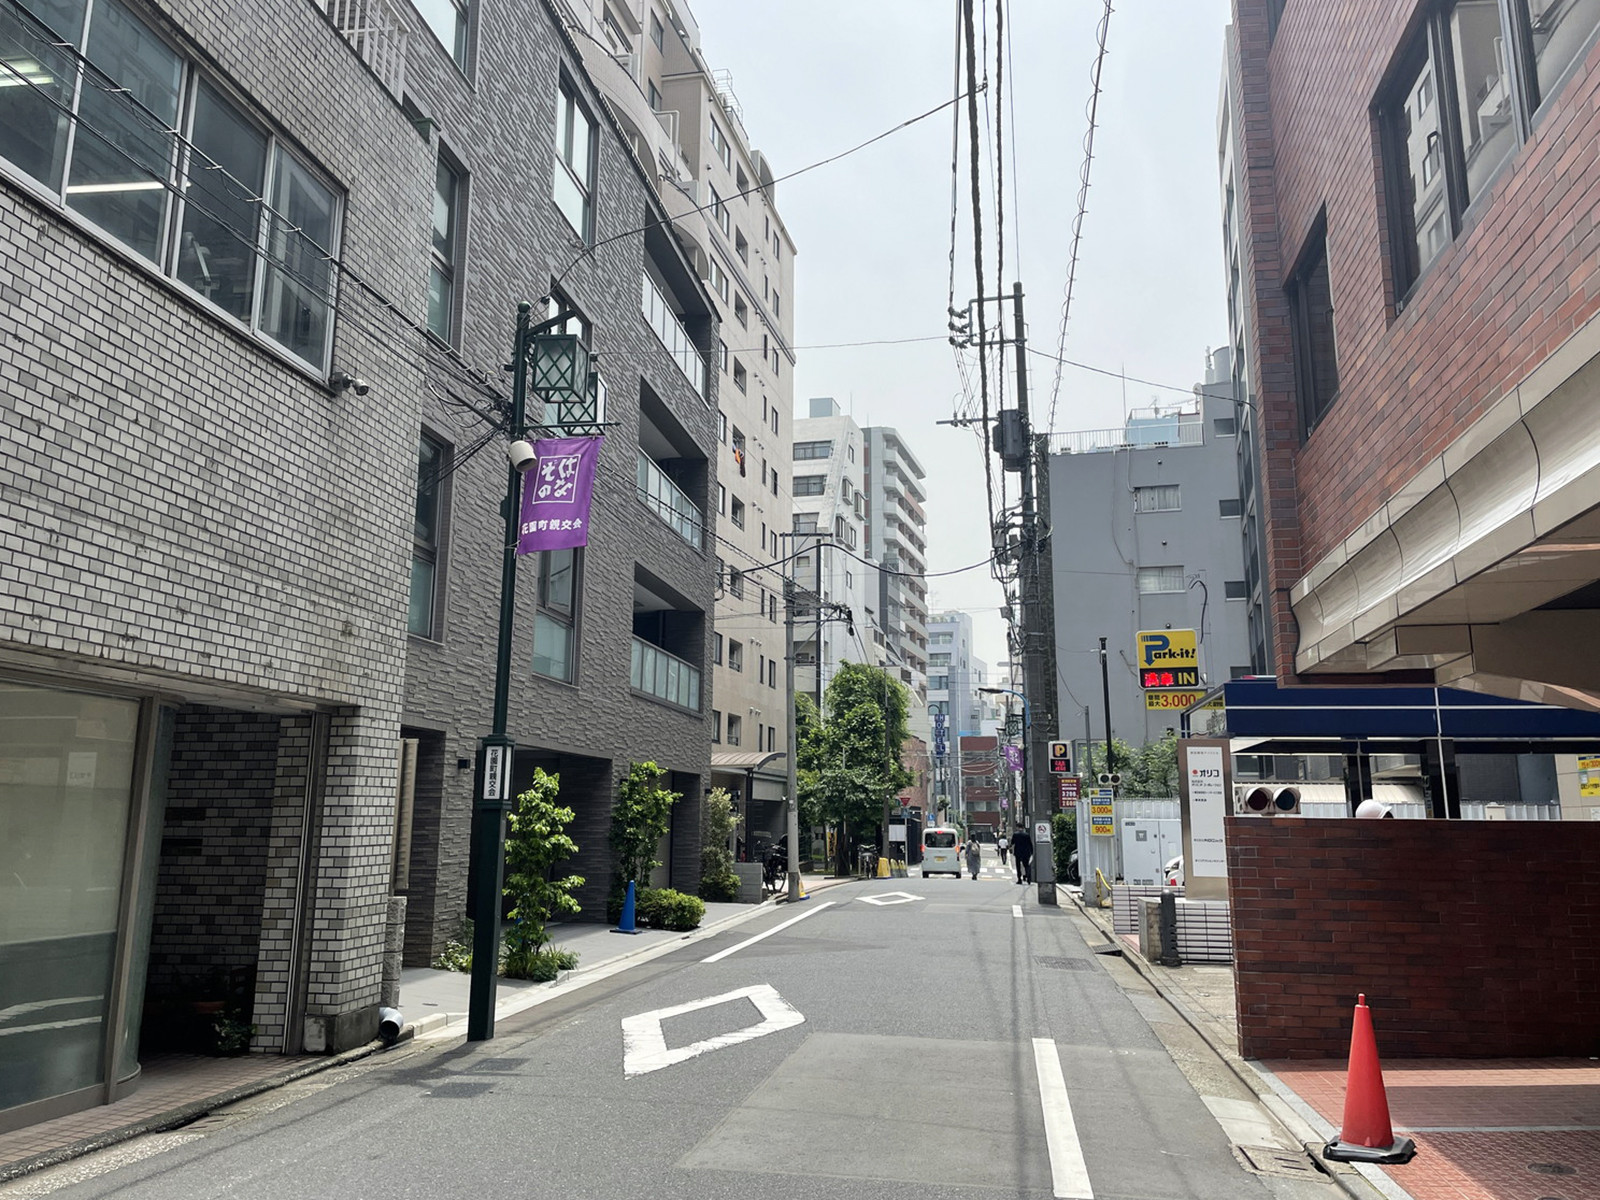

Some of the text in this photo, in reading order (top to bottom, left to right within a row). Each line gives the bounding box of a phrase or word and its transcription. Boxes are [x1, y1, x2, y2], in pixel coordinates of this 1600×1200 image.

[1178, 672, 1195, 685] IN
[1161, 694, 1196, 707] 3,000
[1199, 769, 1220, 778] オリコ
